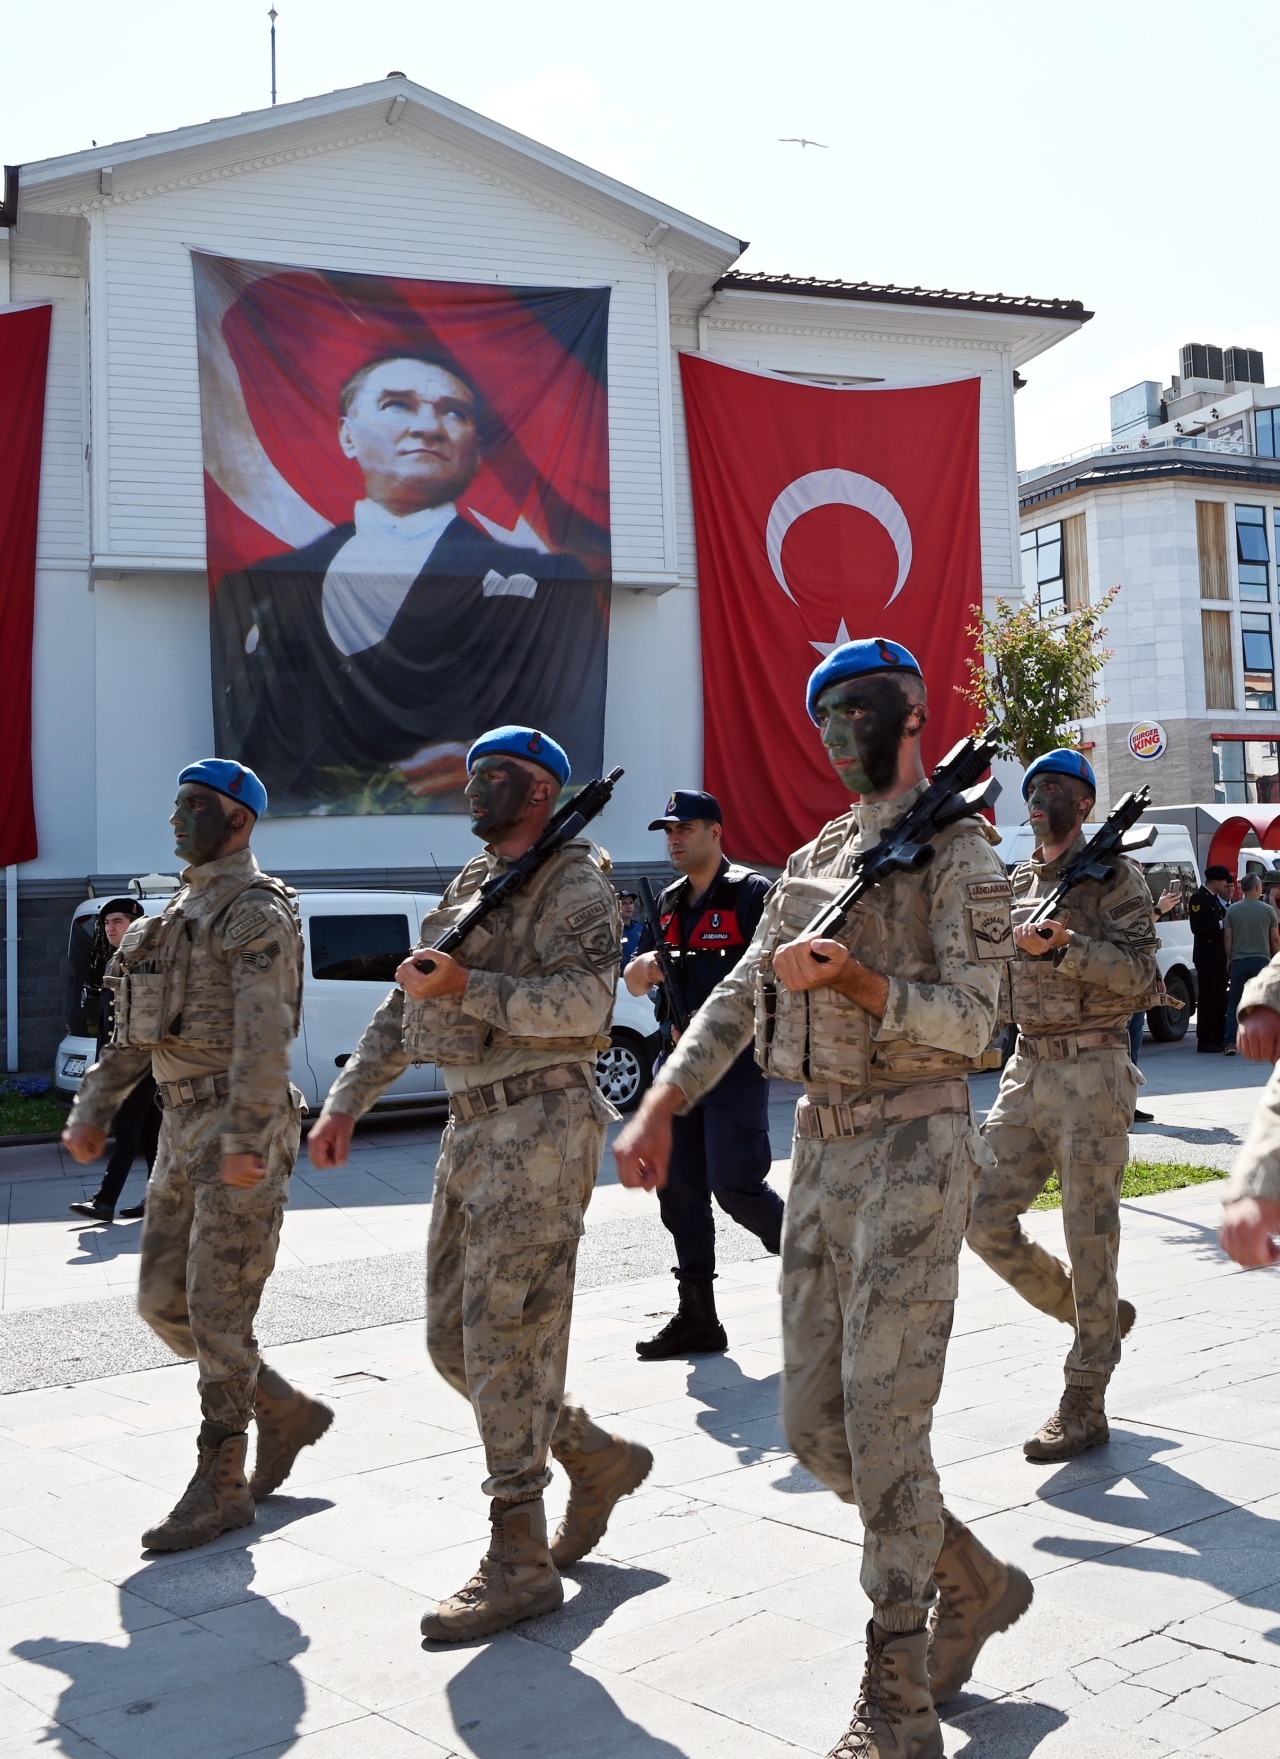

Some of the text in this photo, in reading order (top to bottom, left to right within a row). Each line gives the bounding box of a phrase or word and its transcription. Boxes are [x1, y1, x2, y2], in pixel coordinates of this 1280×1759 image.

[1132, 728, 1159, 744] BURGER
[1133, 734, 1160, 753] KING
[971, 884, 1011, 896] JANDARMA
[572, 905, 604, 926] JANDARMA
[981, 916, 1005, 928] UZMAN
